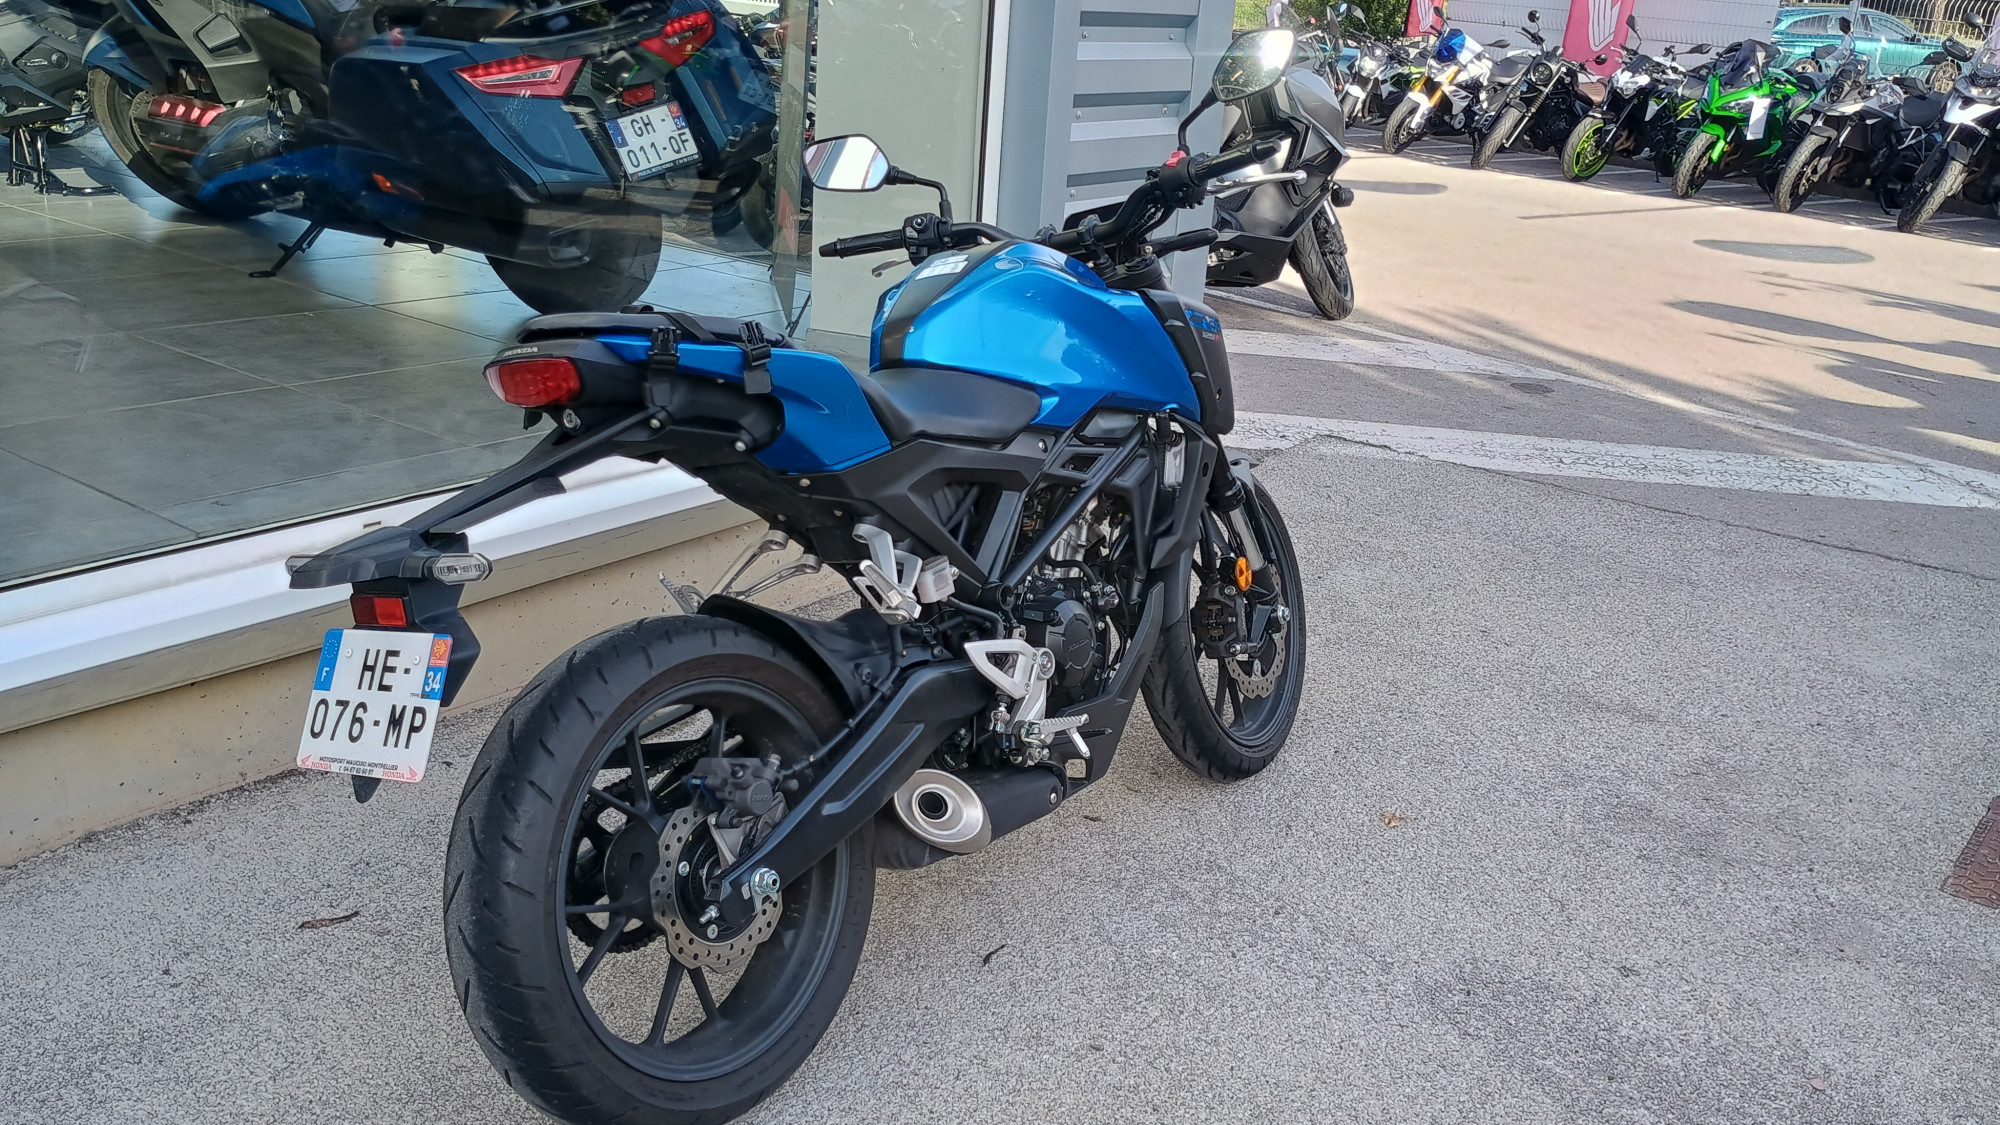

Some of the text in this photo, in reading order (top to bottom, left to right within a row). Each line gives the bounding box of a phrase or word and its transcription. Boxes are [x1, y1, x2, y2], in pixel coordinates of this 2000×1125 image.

[674, 117, 686, 129] 34
[626, 131, 690, 169] 011-QF
[503, 346, 539, 357] HONDA
[320, 667, 330, 682] F
[424, 671, 442, 693] 34
[309, 698, 427, 750] 076-MP
[310, 761, 332, 770] HONDA
[319, 756, 346, 765] MOTOSPORT
[367, 761, 399, 771] MONTPELLIER
[382, 770, 405, 779] HONDA
